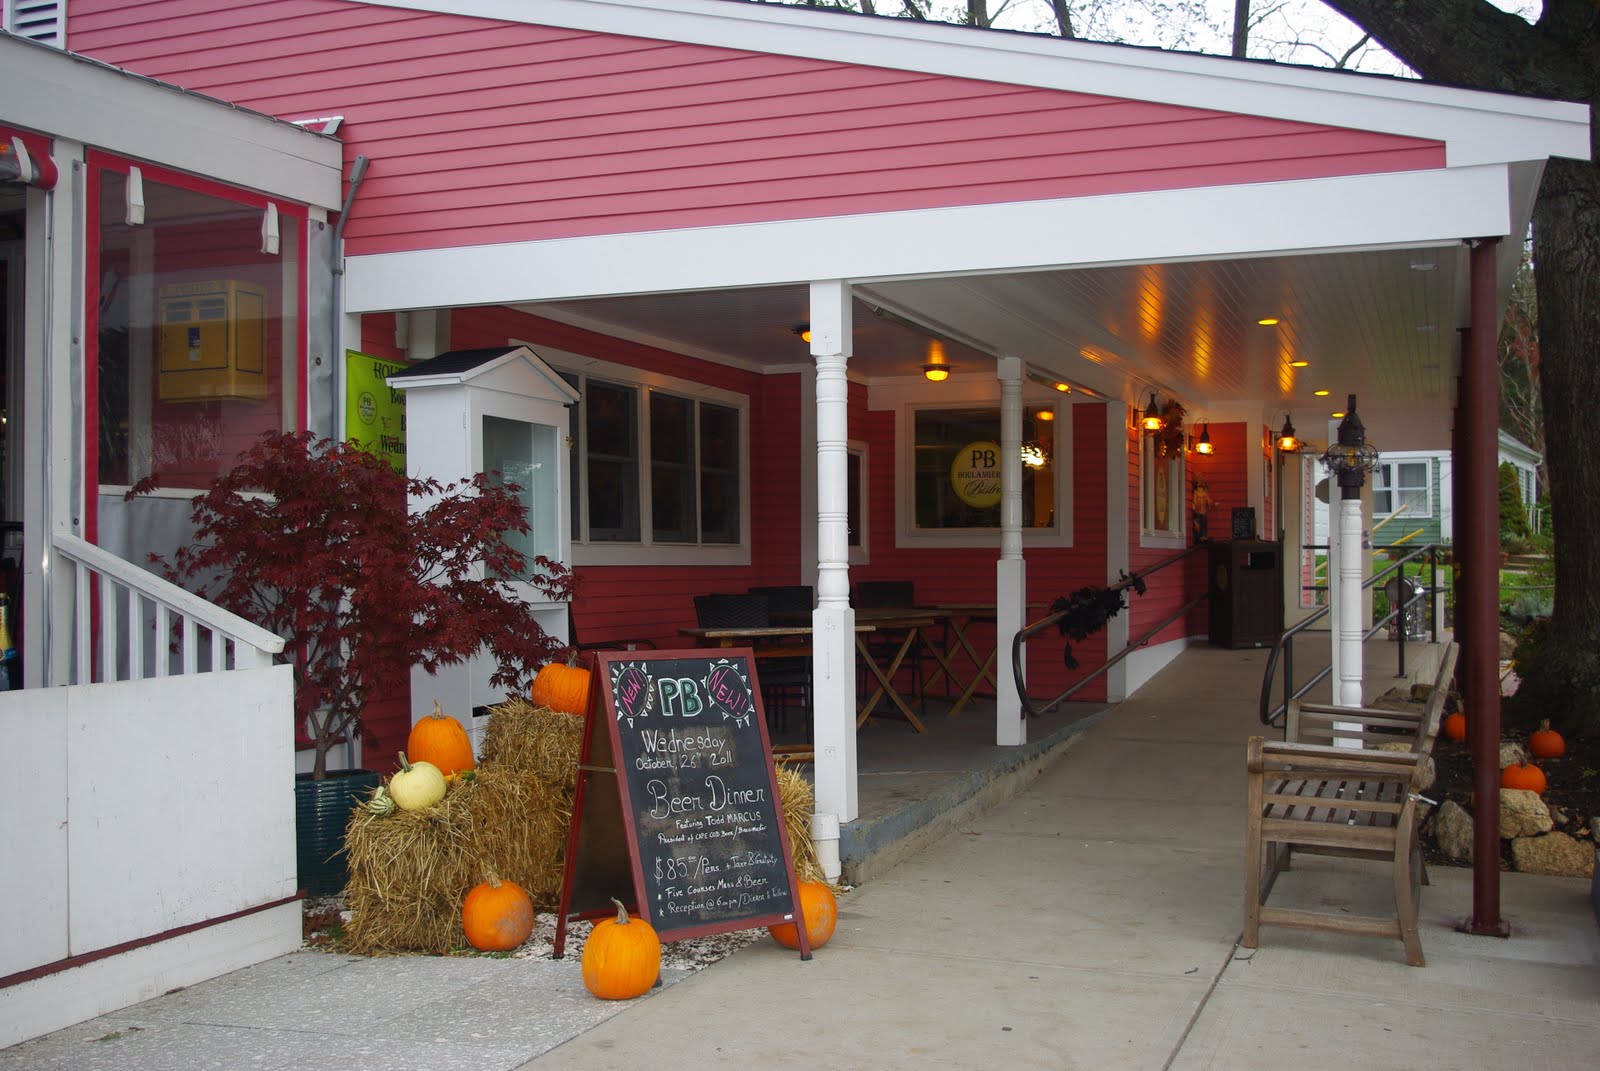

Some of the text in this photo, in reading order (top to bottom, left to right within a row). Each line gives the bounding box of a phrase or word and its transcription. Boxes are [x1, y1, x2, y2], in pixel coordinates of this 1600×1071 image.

[380, 435, 407, 455] Wedn
[971, 450, 996, 468] PB
[657, 677, 703, 717] PB
[641, 728, 726, 755] Wednesday
[646, 775, 765, 820] Beer Dinner
[705, 815, 725, 826] Todd
[727, 811, 762, 824] MARCUS
[665, 886, 684, 899] Five
[743, 874, 769, 889] Beer
[667, 898, 705, 916] Reception
